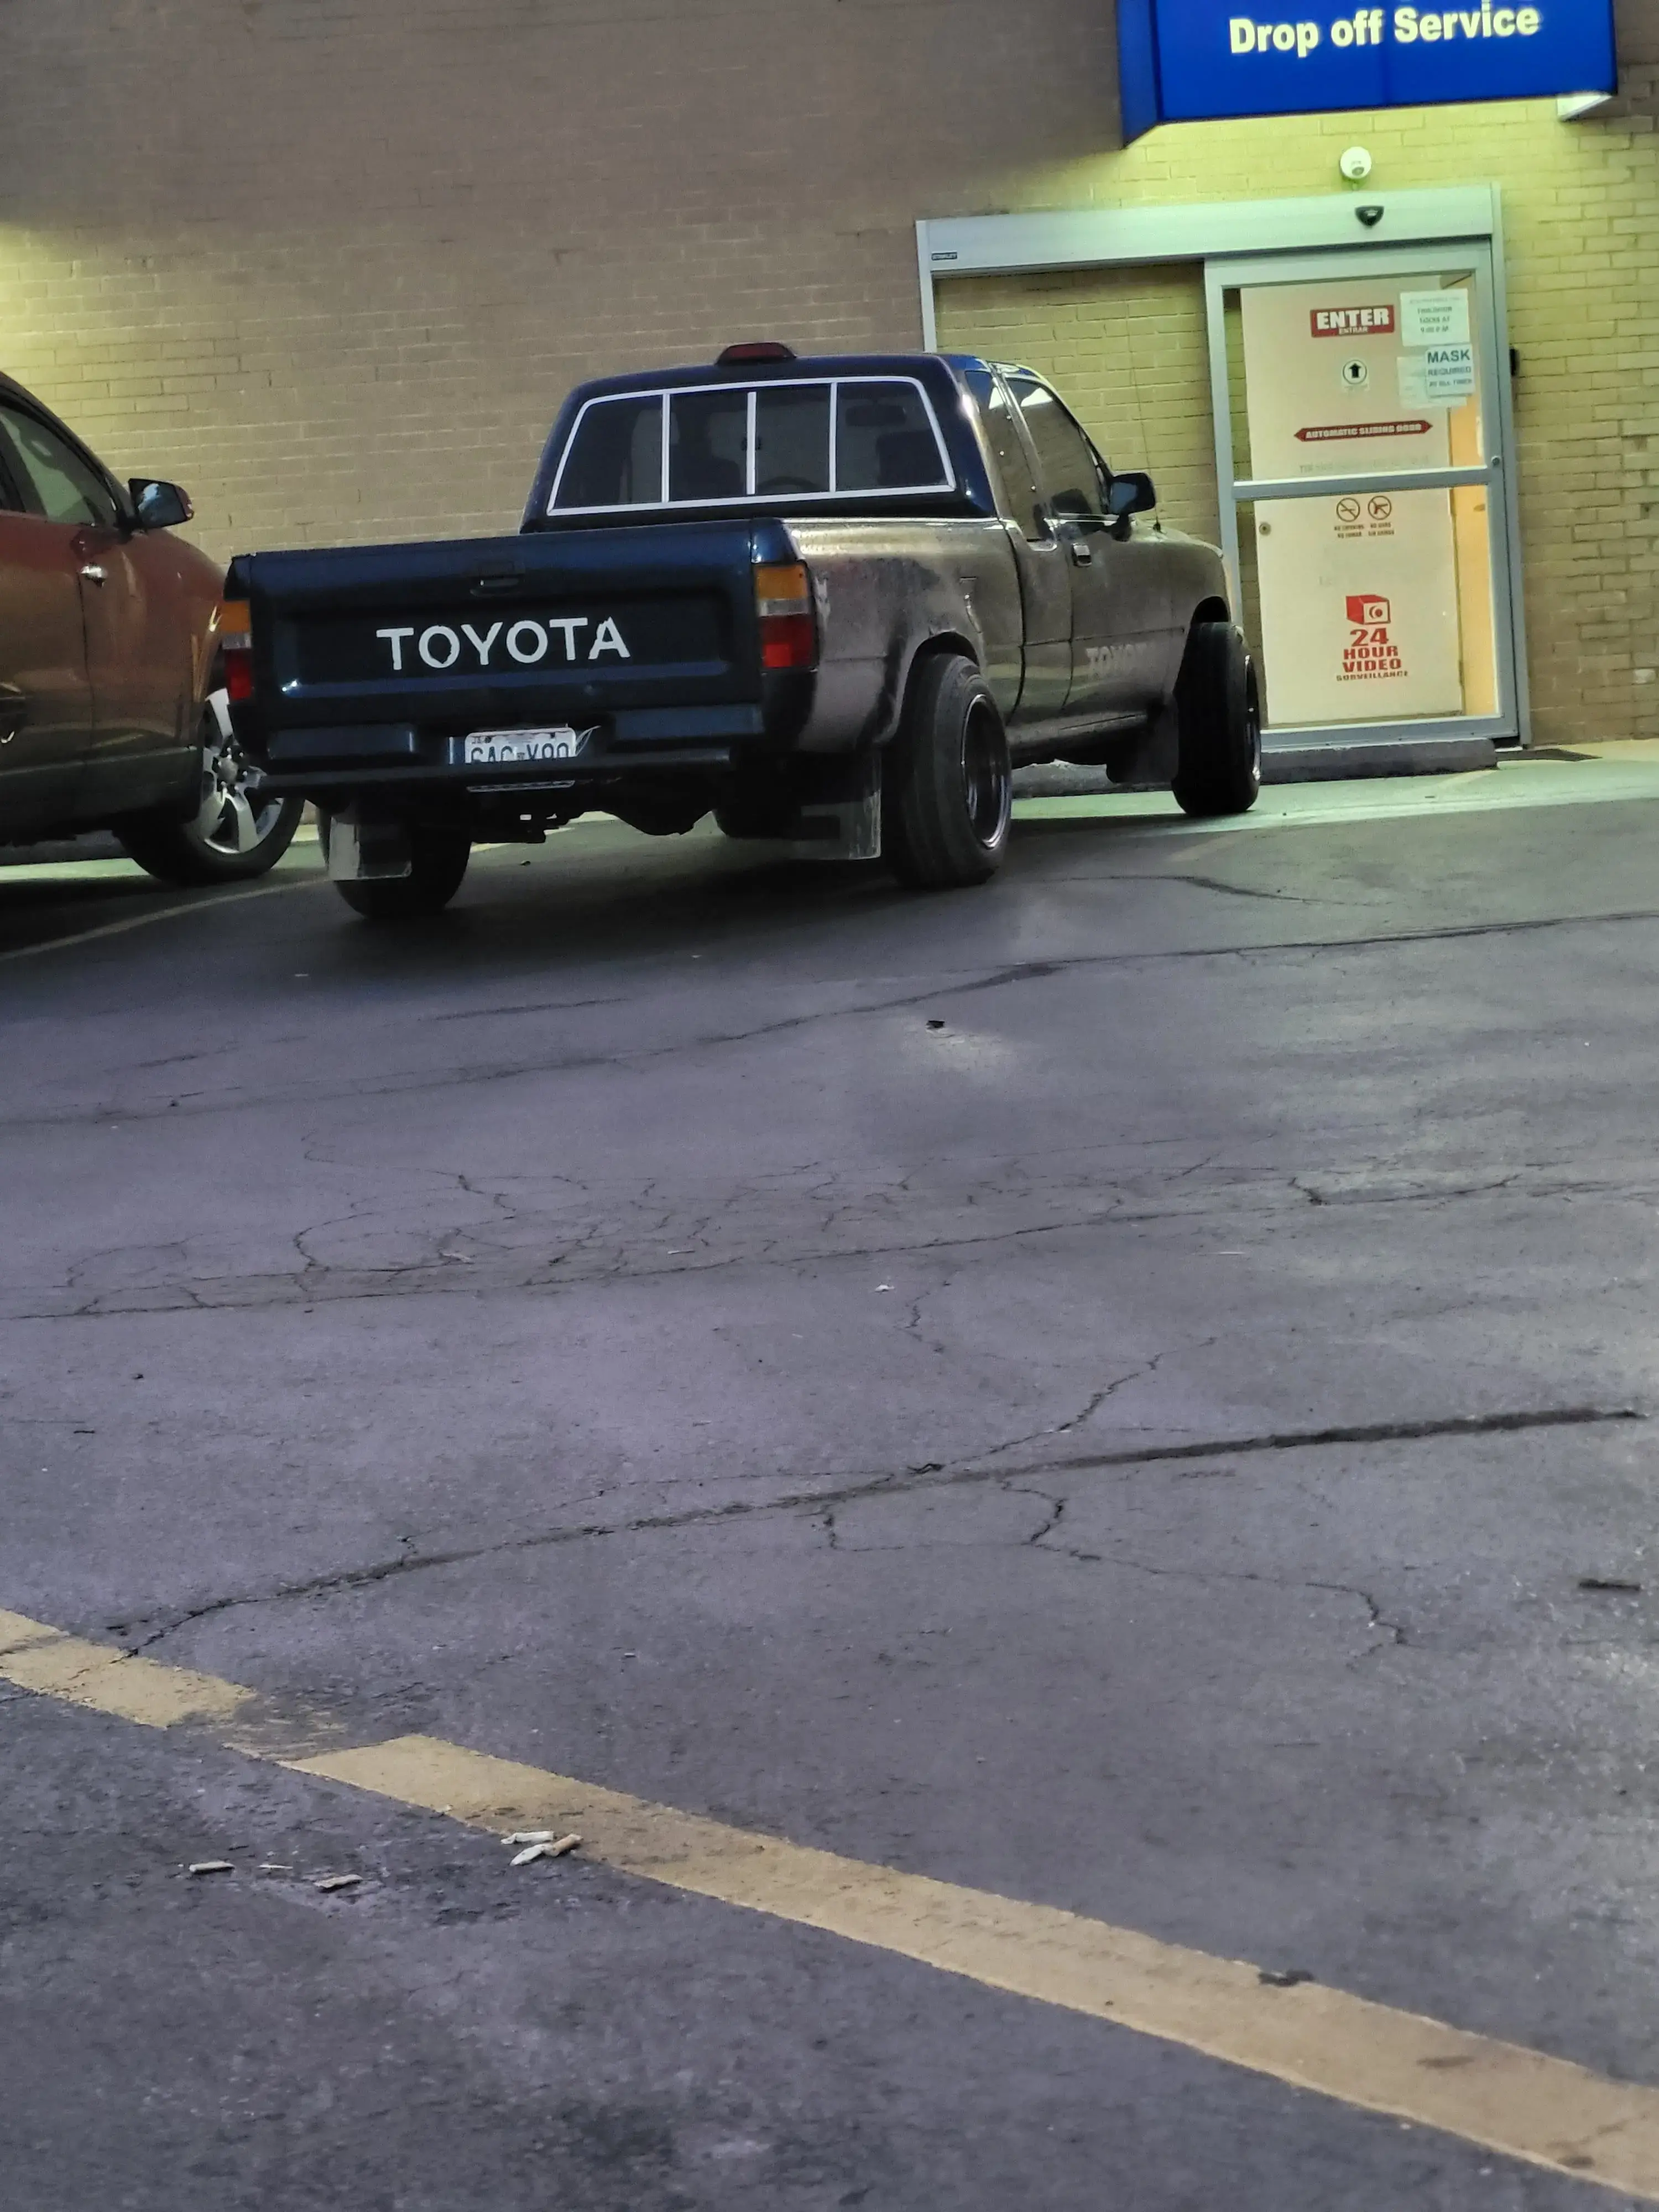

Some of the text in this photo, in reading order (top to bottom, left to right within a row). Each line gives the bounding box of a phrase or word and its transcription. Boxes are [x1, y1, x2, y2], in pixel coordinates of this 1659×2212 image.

[1229, 0, 1540, 58] Drop off Service
[1317, 308, 1389, 330] ENTER
[1428, 349, 1470, 364] MASK
[1428, 367, 1472, 376] REQUIRED
[1306, 427, 1358, 439] AUTOMATIC
[376, 617, 630, 670] TOYOTA
[1350, 628, 1389, 647] 24
[1344, 646, 1398, 660] HOUR
[1343, 658, 1401, 673] VIDEO
[1336, 670, 1408, 681] SURVEILLANCE
